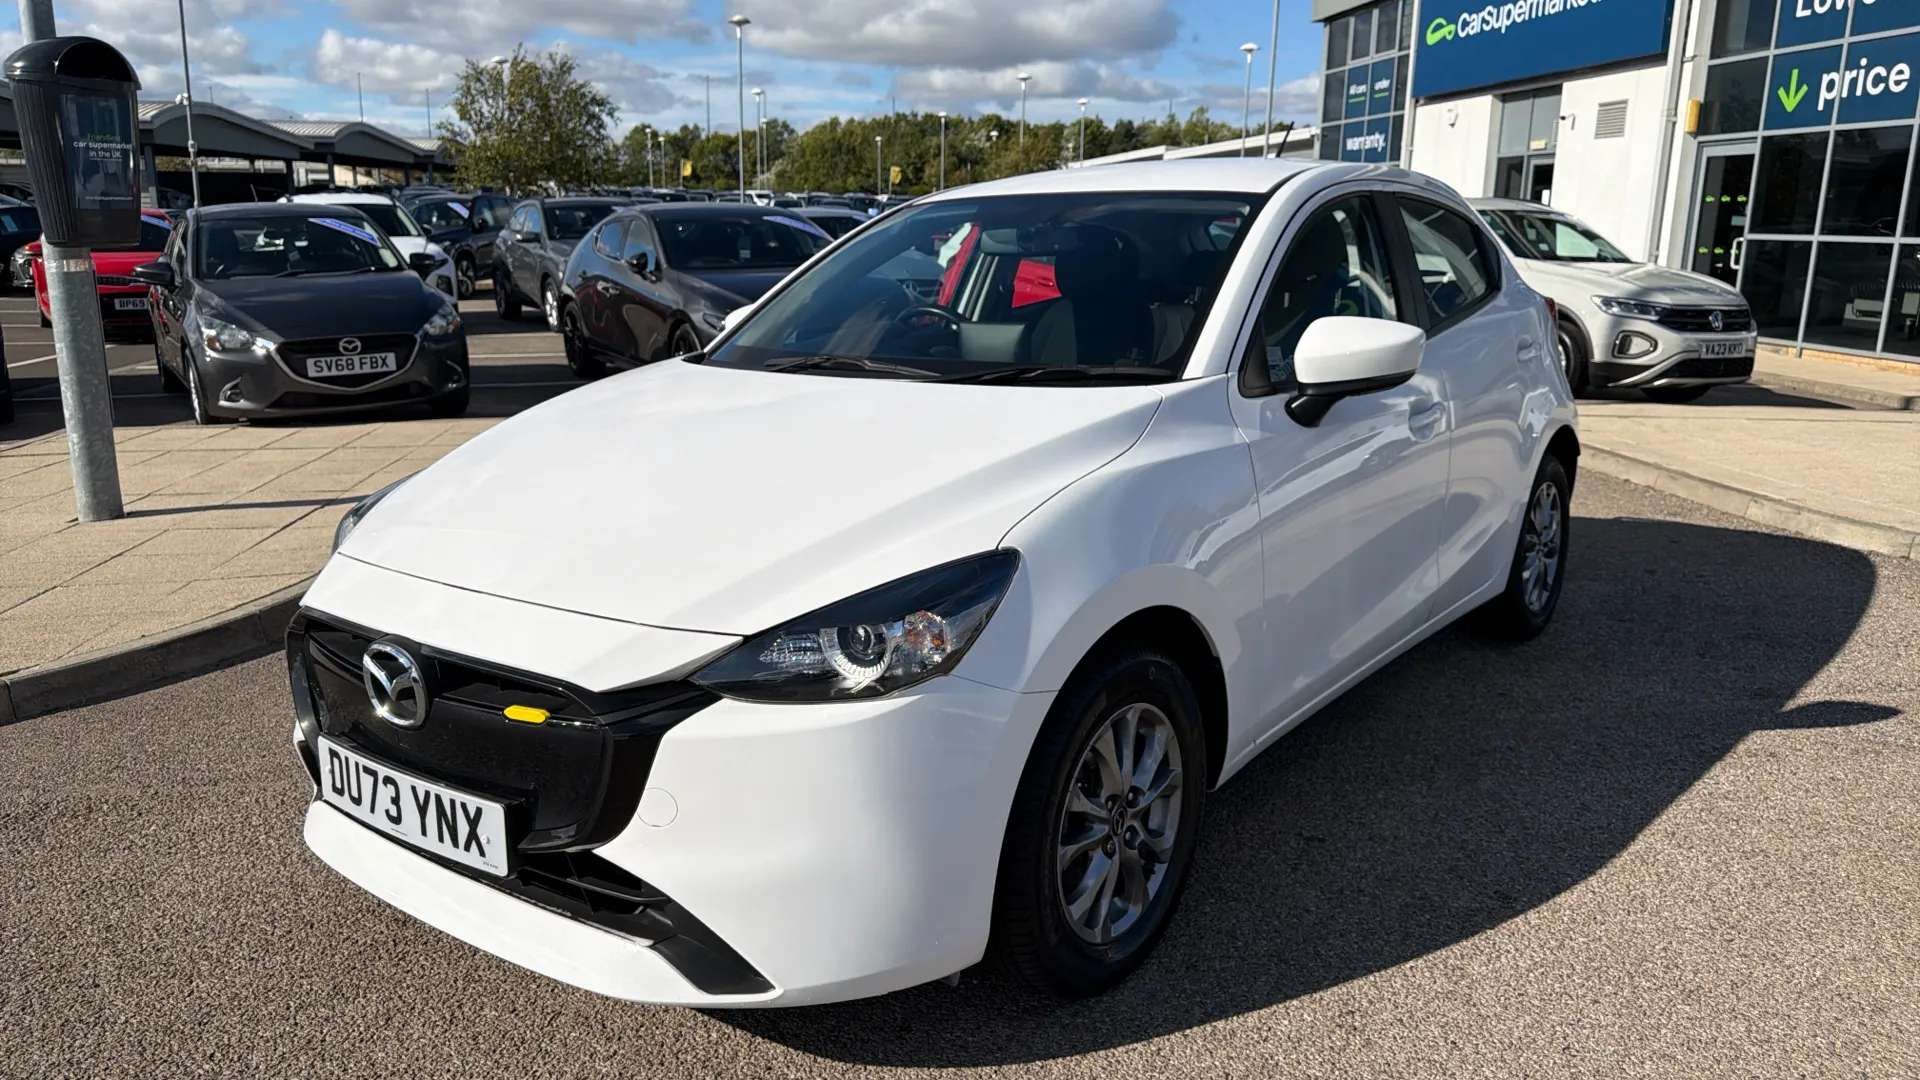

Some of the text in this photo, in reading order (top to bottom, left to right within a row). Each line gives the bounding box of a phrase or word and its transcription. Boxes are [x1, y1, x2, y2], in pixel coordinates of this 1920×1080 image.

[1817, 57, 1911, 111] price
[98, 150, 111, 158] the
[313, 355, 389, 373] SV68 FBX
[328, 747, 487, 858] DU73 YNX
